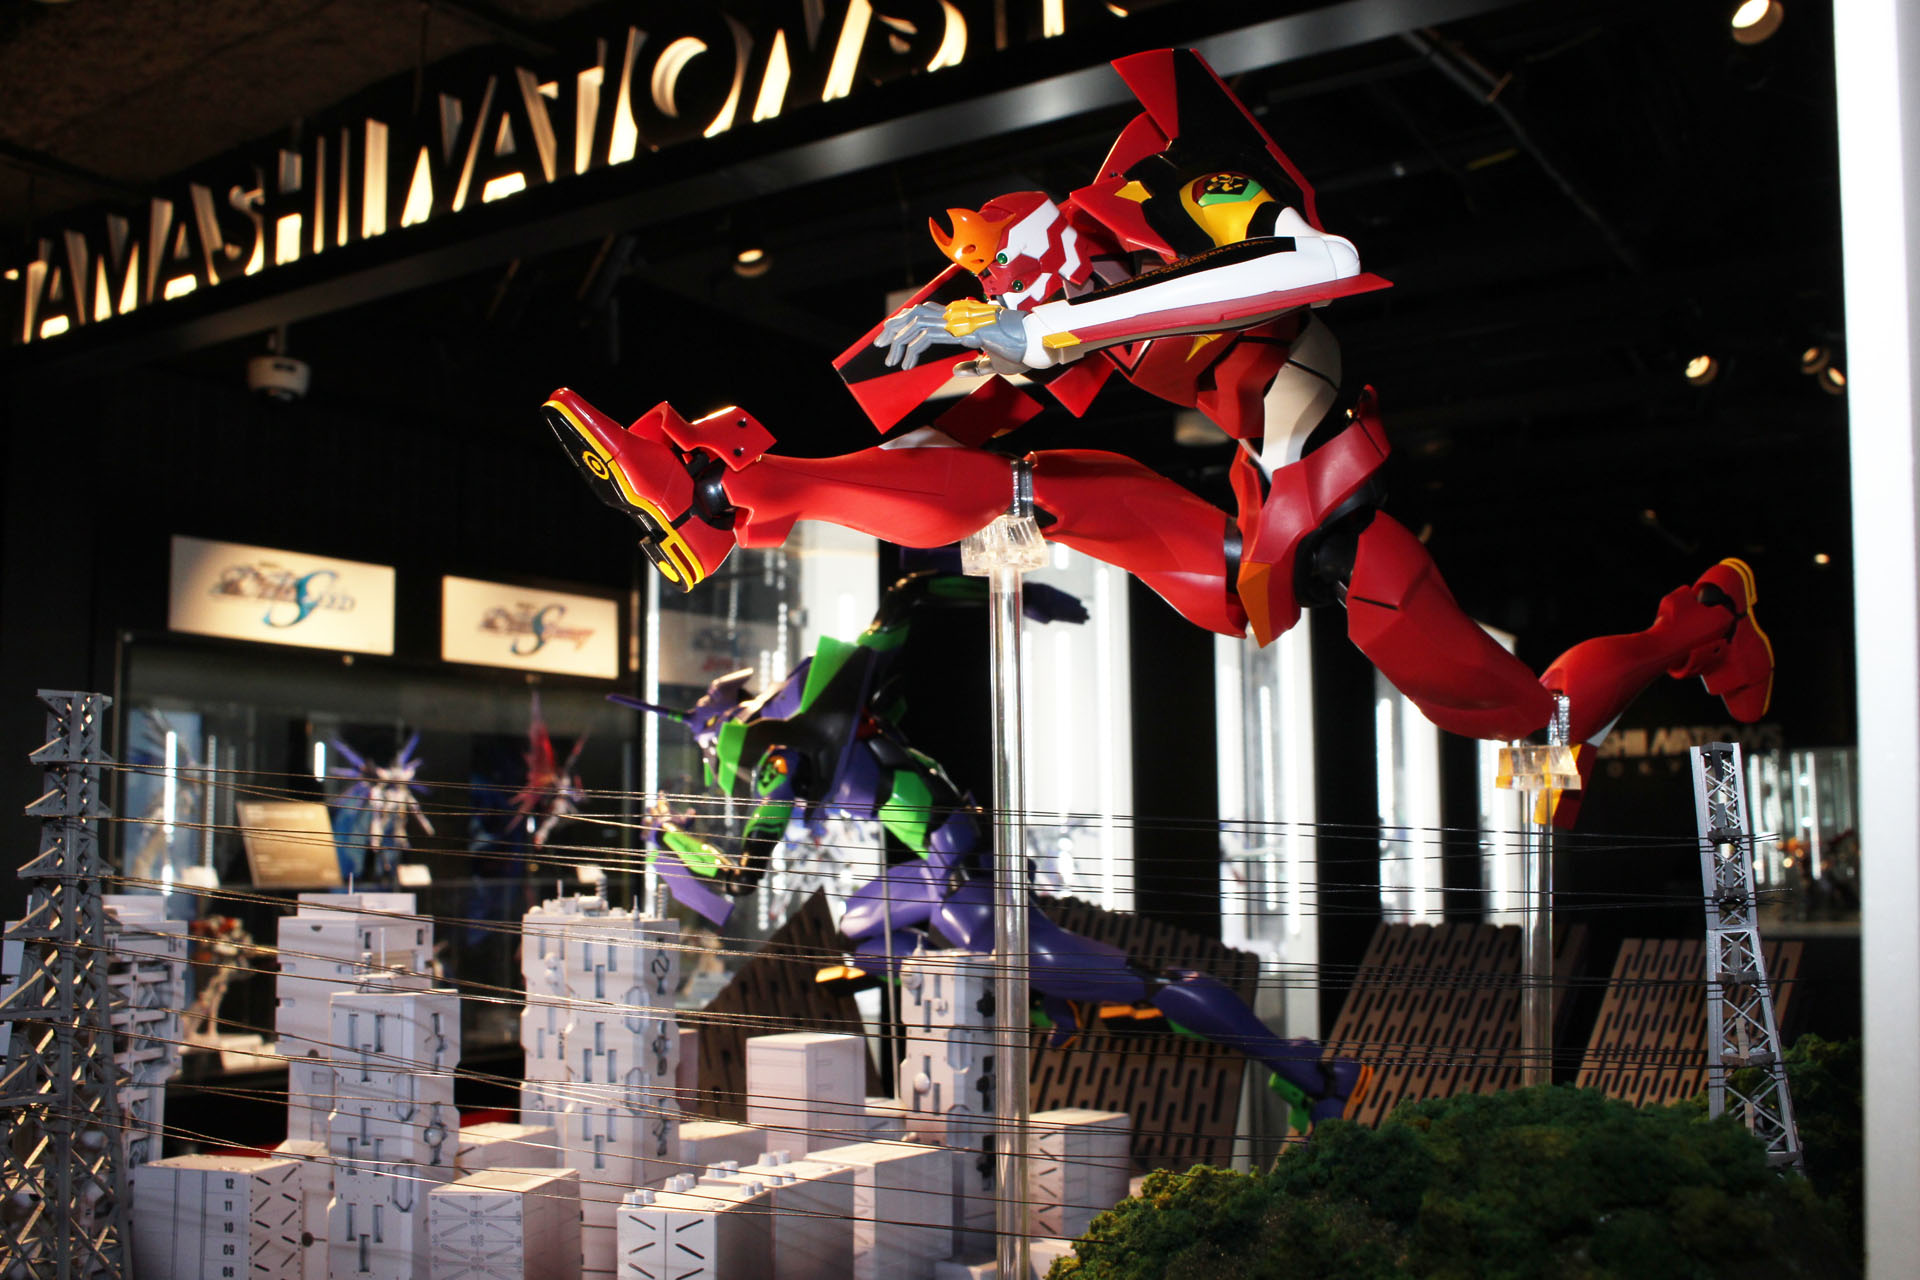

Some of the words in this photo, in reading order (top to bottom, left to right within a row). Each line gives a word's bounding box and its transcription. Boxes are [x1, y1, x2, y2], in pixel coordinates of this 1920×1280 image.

[225, 1178, 234, 1189] 12
[224, 1201, 233, 1211] 11
[224, 1222, 234, 1233] 10
[223, 1244, 235, 1255] 09
[222, 1266, 234, 1278] 08
